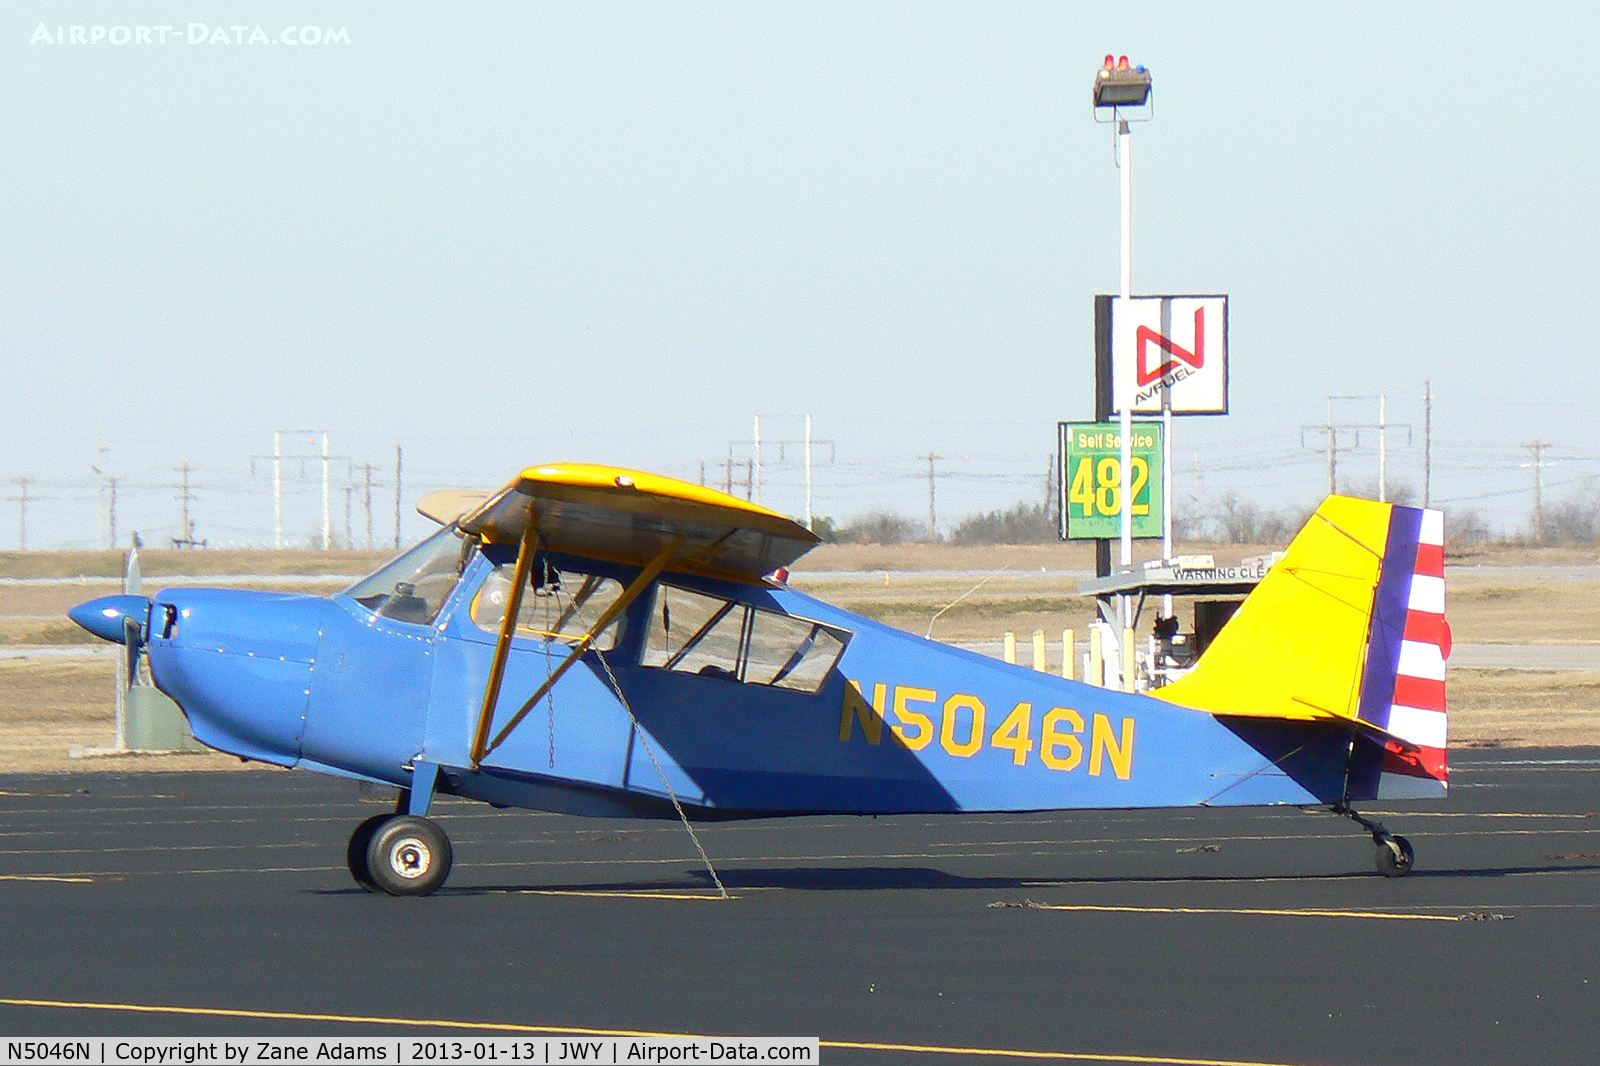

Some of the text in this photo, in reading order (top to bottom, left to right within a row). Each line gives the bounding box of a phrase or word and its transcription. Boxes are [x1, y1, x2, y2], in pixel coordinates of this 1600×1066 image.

[1135, 367, 1196, 405] AVFUEL
[1078, 433, 1104, 449] Self
[1069, 456, 1149, 516] 482
[1173, 568, 1236, 580] WARNING
[838, 679, 1136, 781] N5046N
